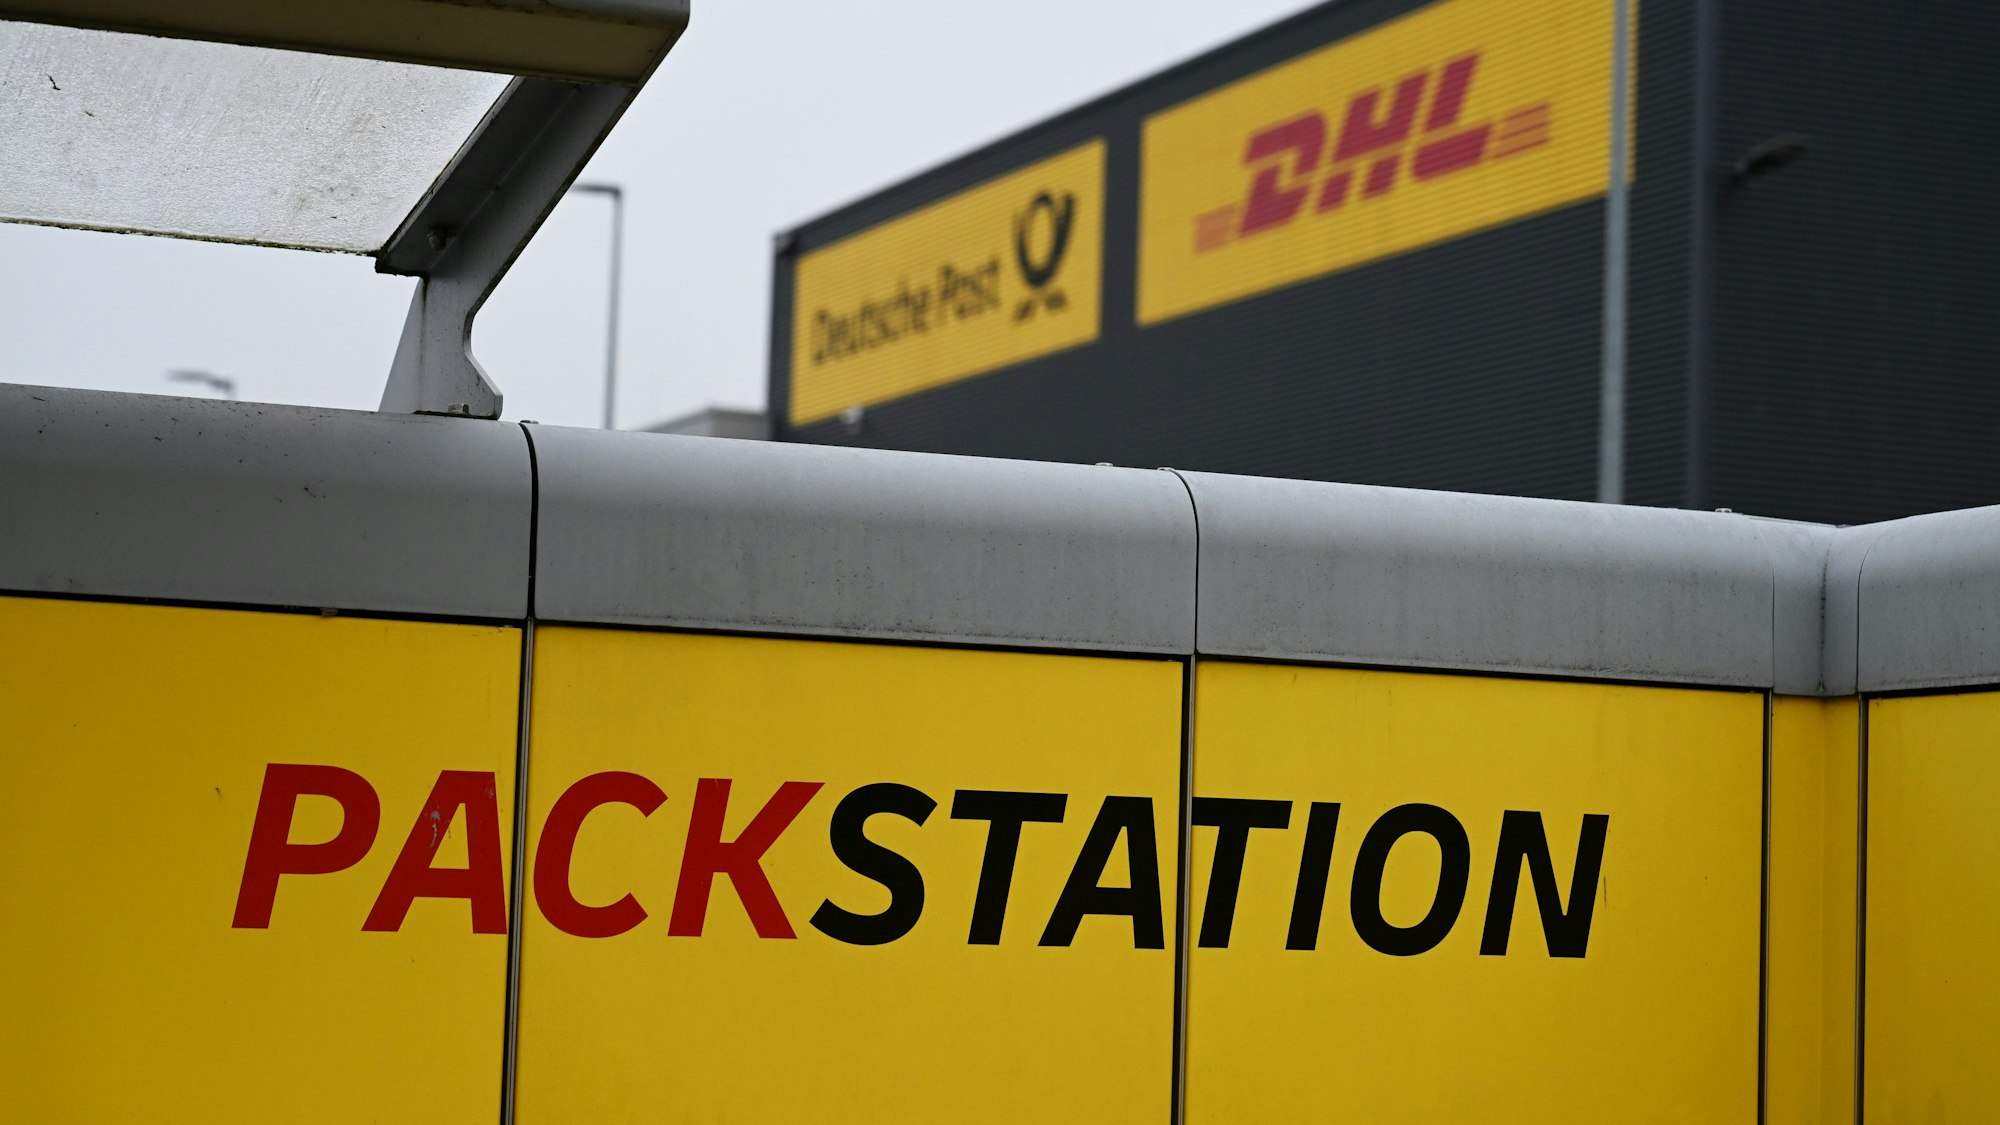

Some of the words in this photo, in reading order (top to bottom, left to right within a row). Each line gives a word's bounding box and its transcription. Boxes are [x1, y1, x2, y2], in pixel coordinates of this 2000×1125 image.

[1239, 51, 1493, 238] DHL
[812, 278, 932, 366] Deutsche
[938, 256, 1002, 324] Post
[231, 763, 1610, 959] PACKSTATION
